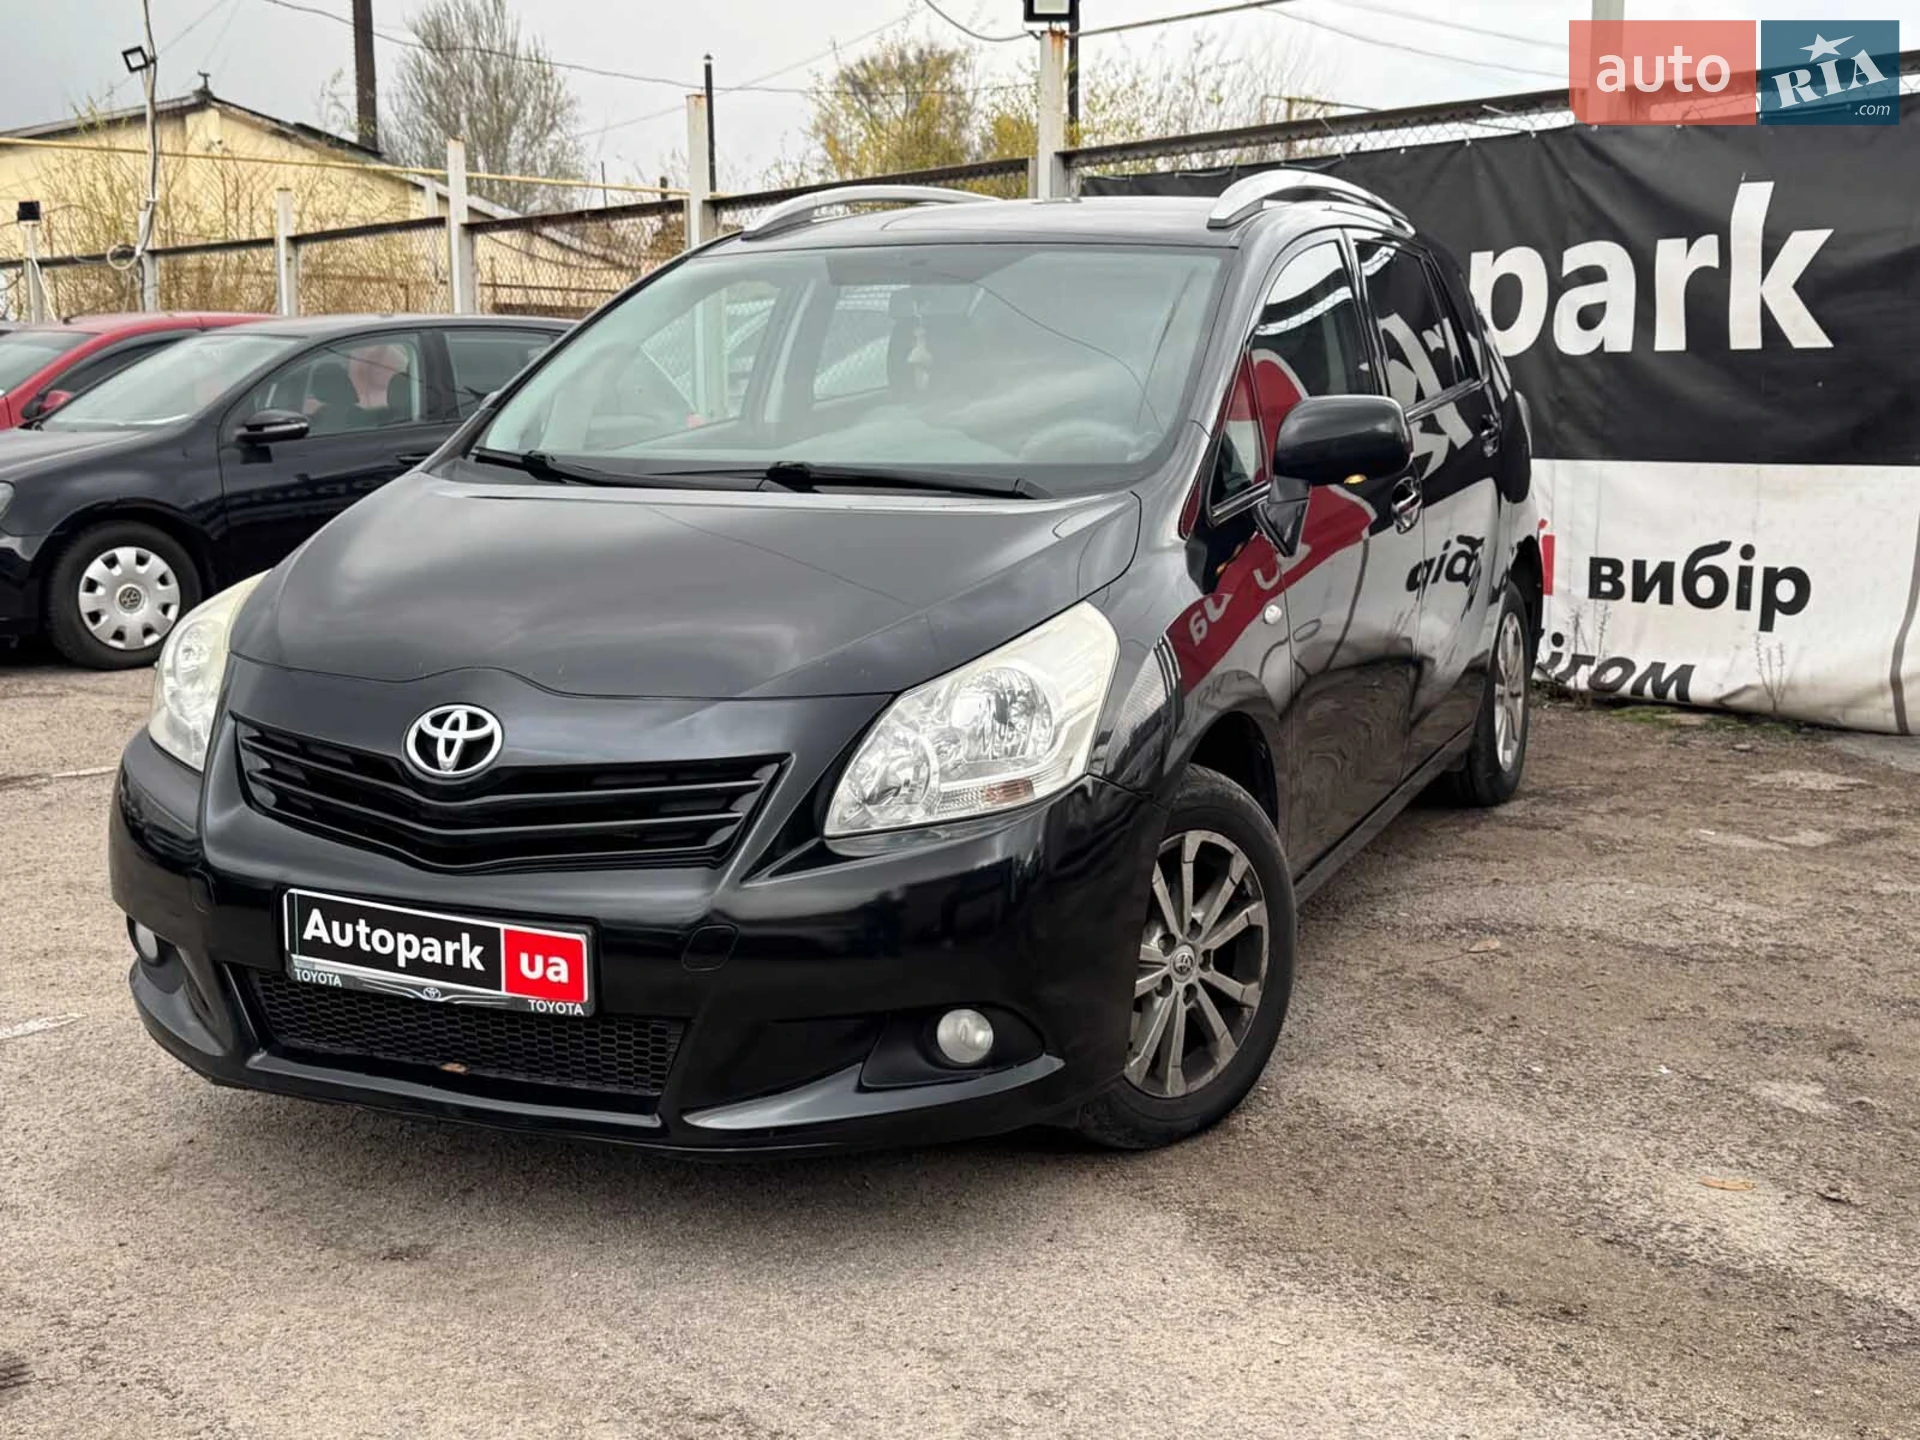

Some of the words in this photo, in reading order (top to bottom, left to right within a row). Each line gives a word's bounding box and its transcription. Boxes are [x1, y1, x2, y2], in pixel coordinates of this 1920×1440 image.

[1588, 540, 1812, 632] вибір
[303, 908, 485, 972] Autopark
[519, 951, 569, 984] ua
[294, 969, 342, 988] TOYOTA
[527, 999, 585, 1017] TOYOTA
